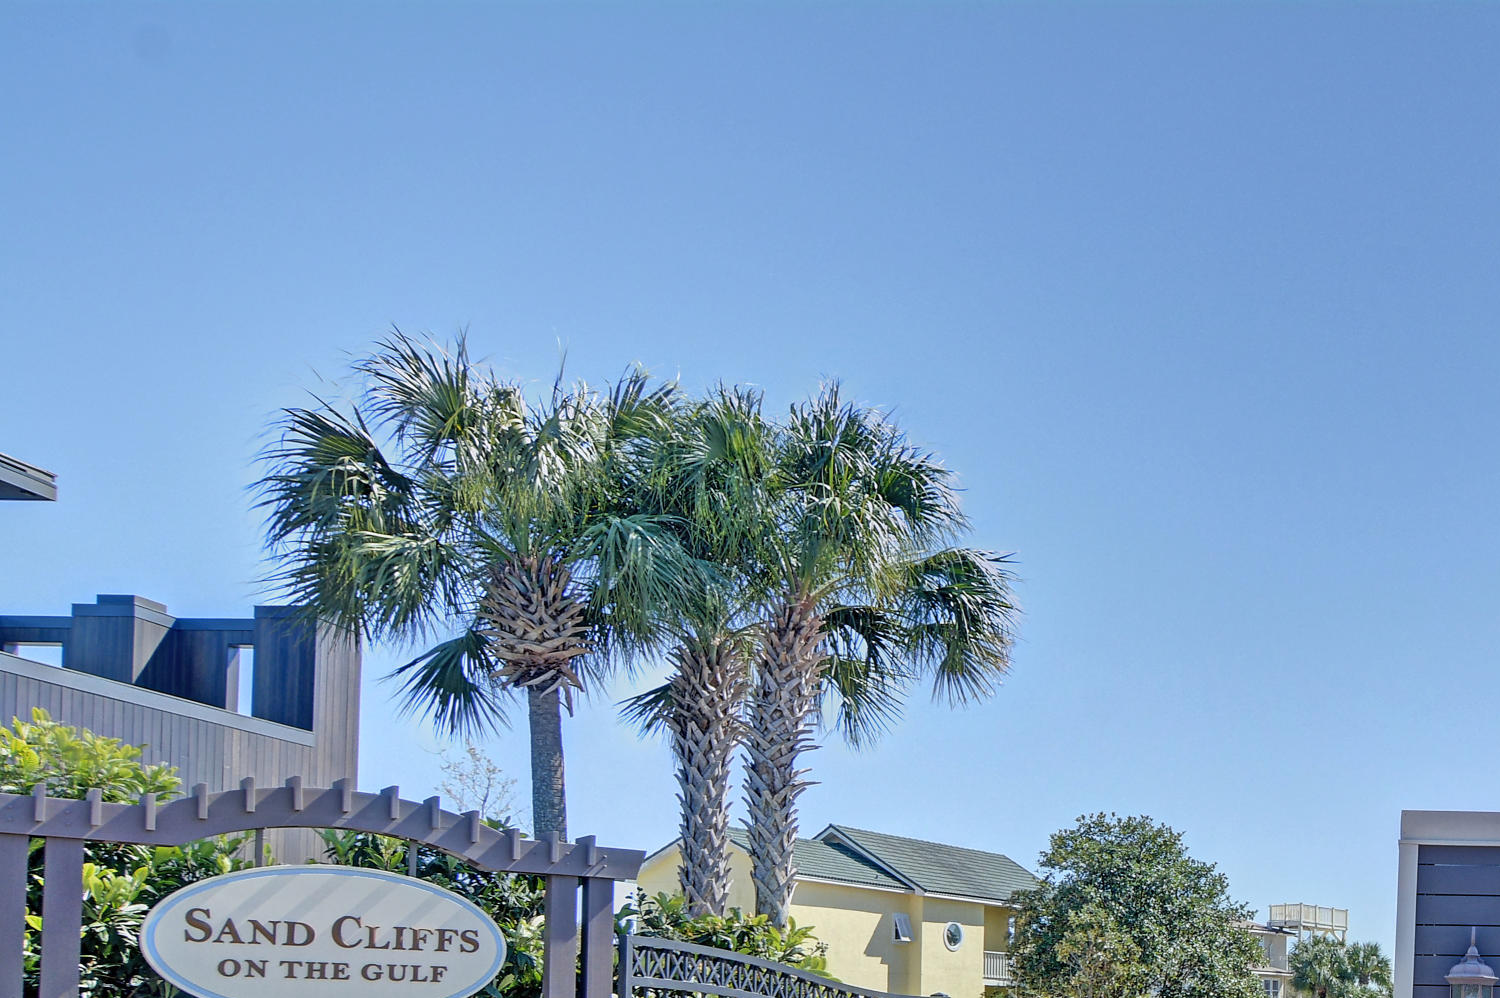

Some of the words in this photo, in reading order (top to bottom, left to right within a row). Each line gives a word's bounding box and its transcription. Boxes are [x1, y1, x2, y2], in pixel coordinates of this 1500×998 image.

[184, 908, 315, 947] SAND
[331, 915, 480, 953] CLIFFS
[217, 958, 269, 978] ON
[279, 960, 350, 980] THE
[360, 963, 448, 983] GULF
